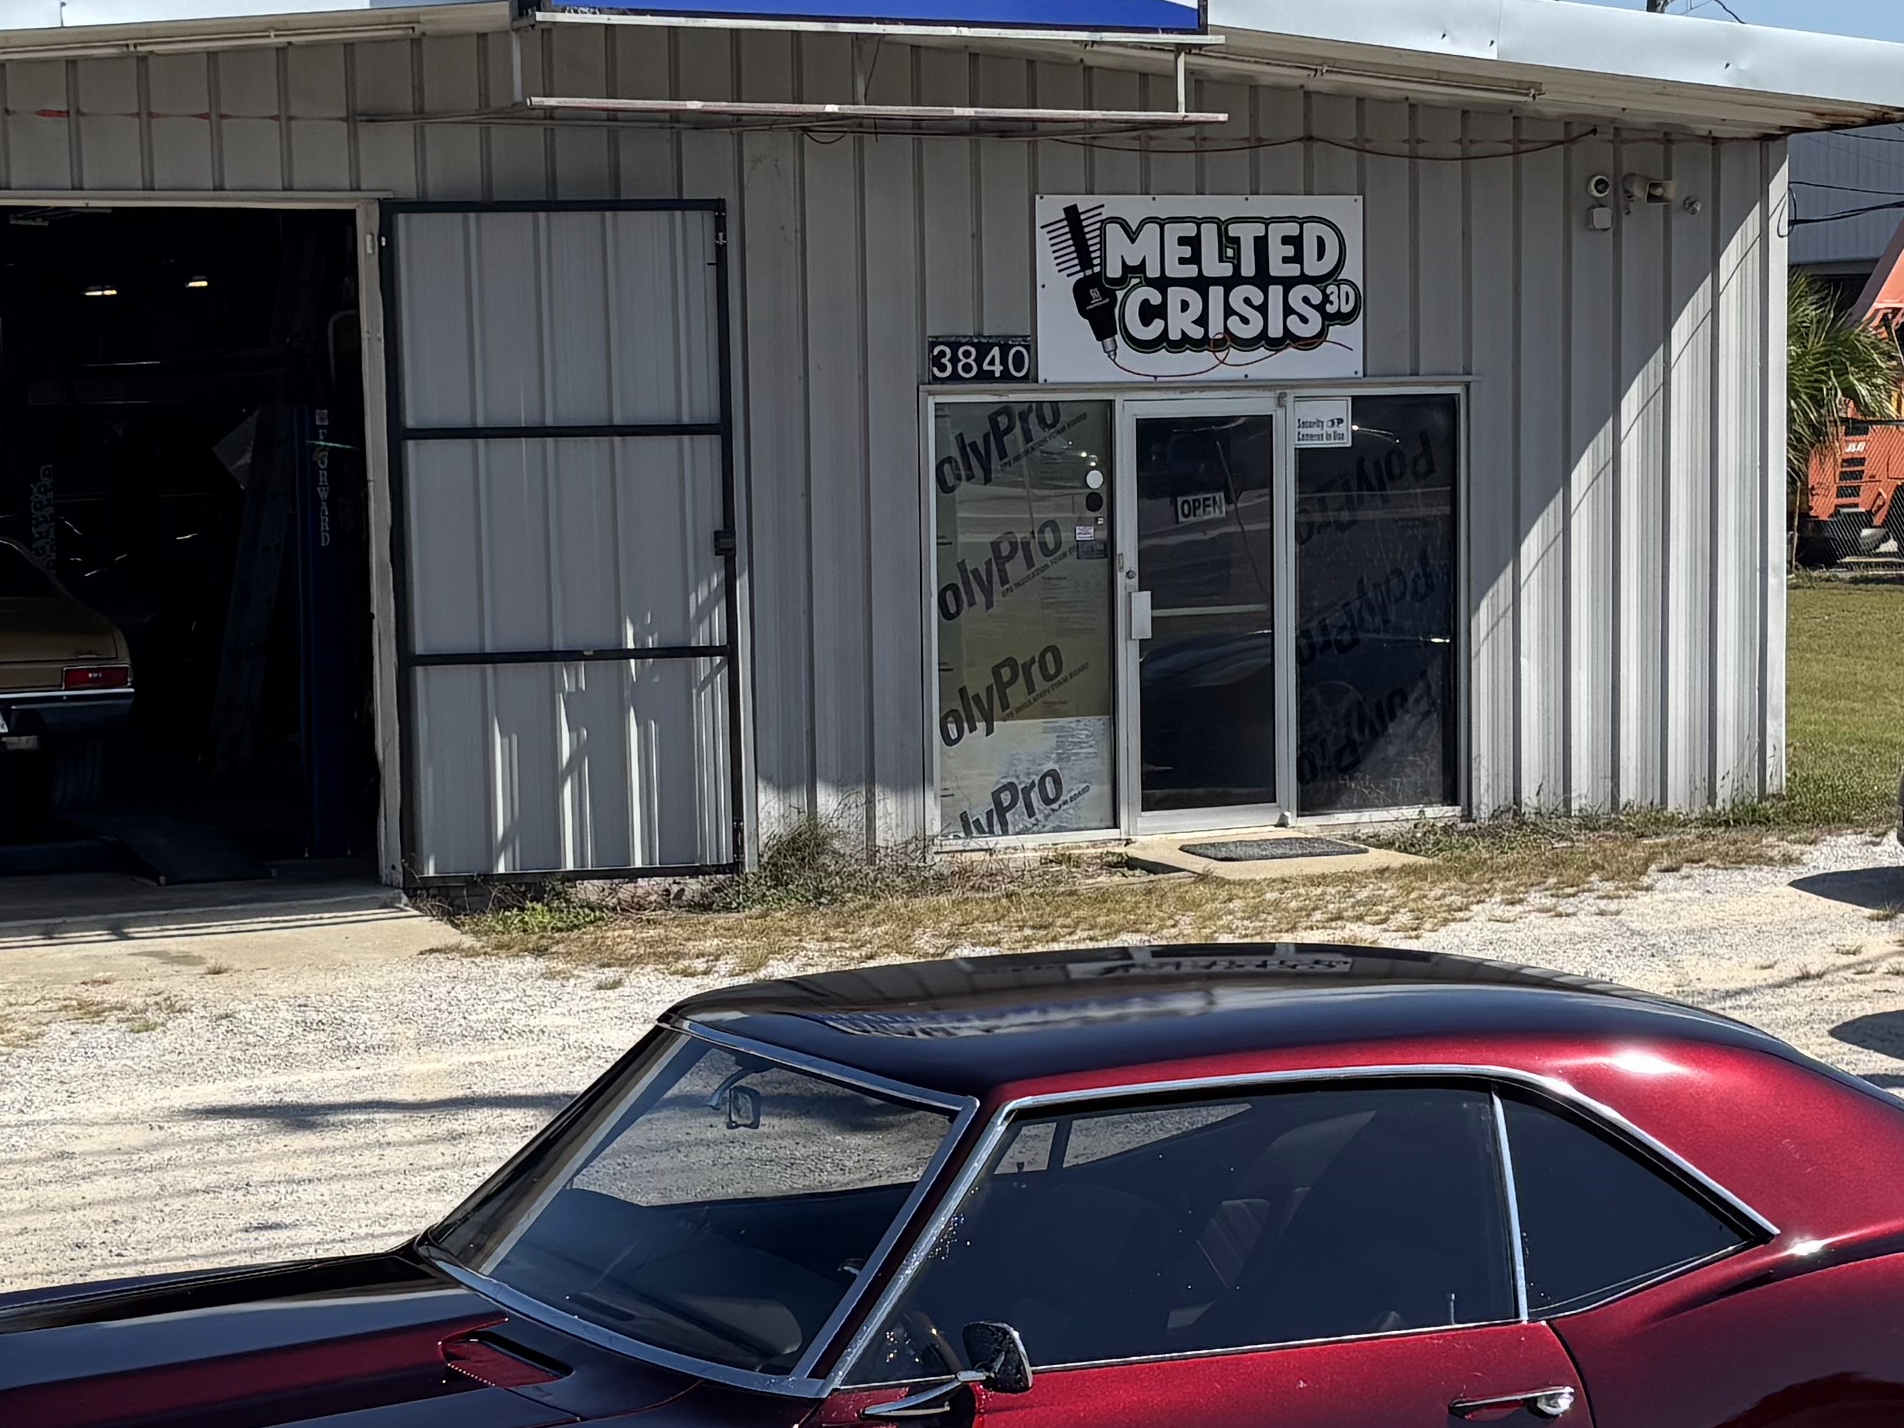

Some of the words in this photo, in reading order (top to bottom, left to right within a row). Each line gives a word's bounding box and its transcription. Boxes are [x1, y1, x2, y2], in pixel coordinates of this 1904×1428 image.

[1105, 222, 1341, 278] MELTED
[1124, 283, 1323, 341] CRISIS
[1324, 284, 1357, 315] 3D
[932, 345, 1030, 379] 3840
[1180, 495, 1224, 520] OPEN
[948, 768, 1064, 837] lyPro
